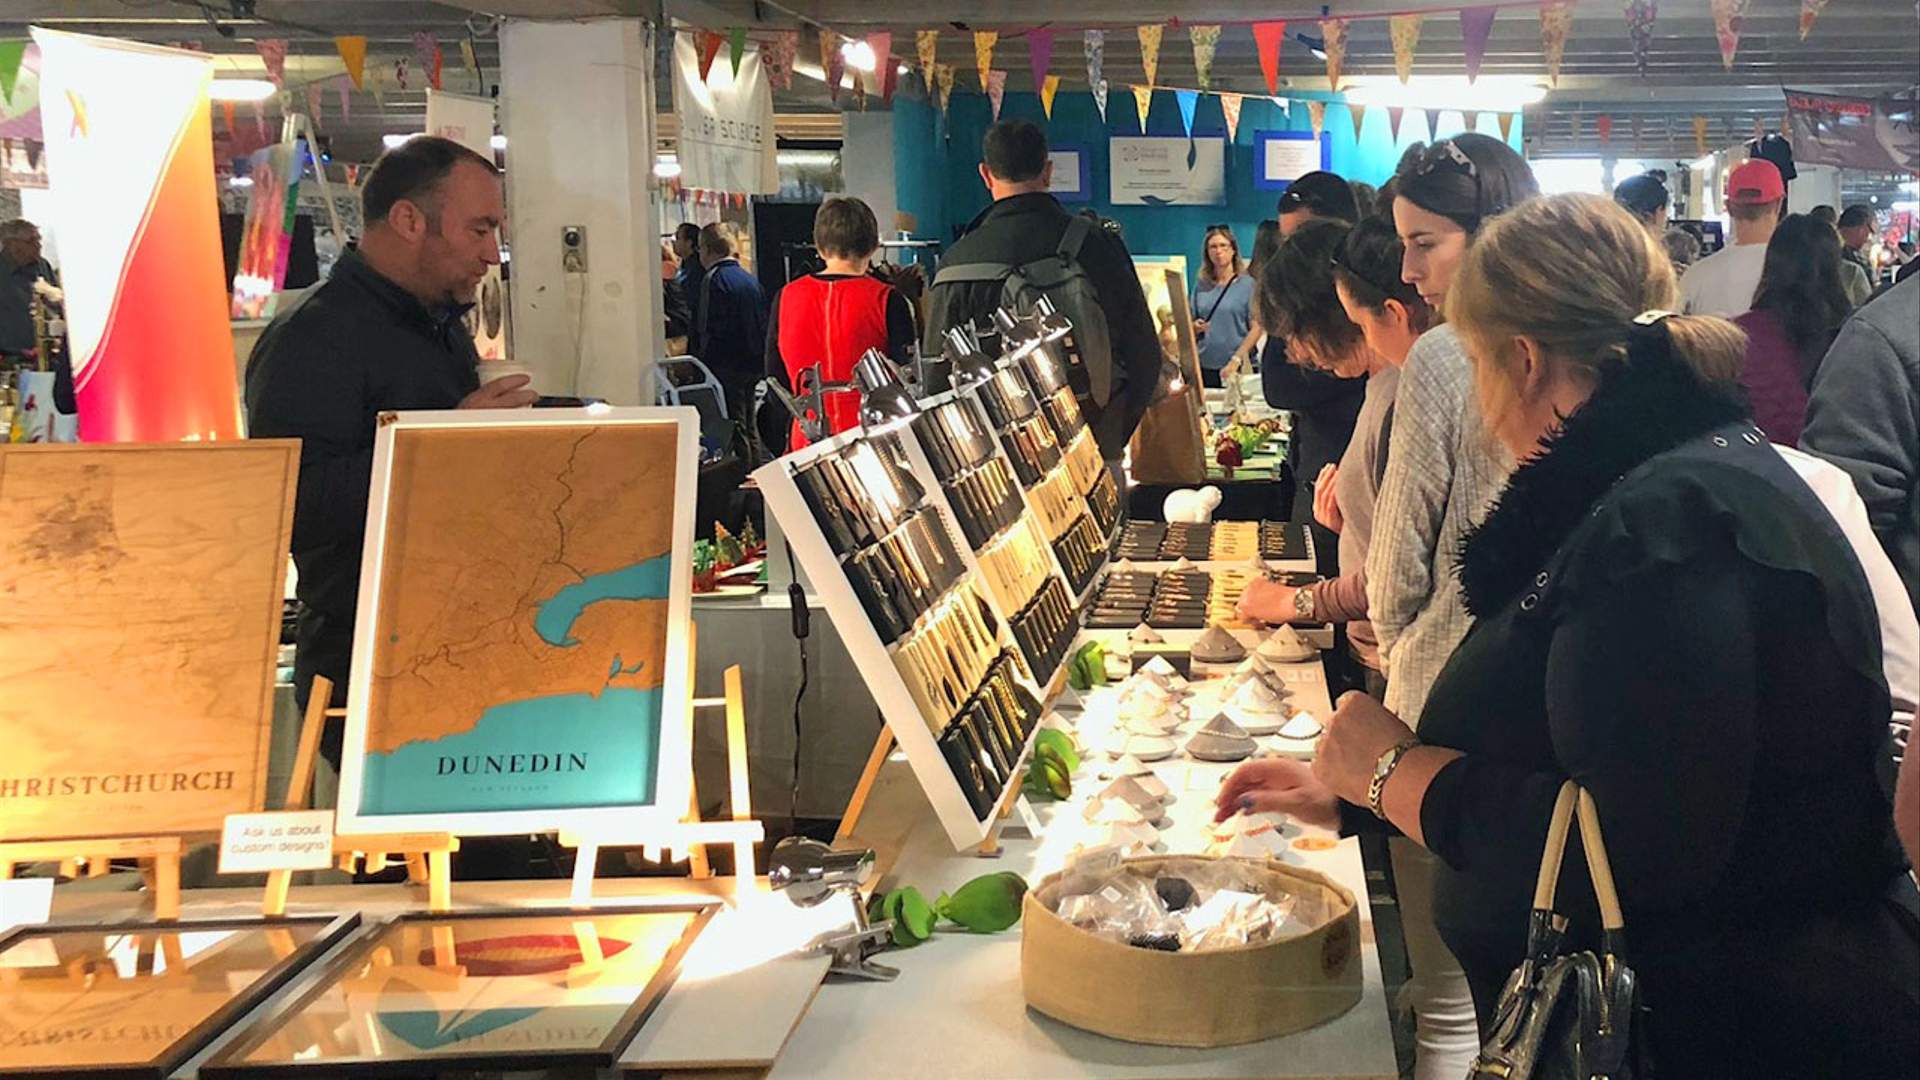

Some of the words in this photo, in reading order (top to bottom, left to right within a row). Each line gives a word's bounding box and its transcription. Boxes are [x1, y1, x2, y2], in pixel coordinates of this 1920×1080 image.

[720, 119, 762, 143] SCIENCE
[436, 752, 588, 776] DUNEDIN
[270, 826, 283, 836] us
[287, 824, 321, 836] about
[230, 842, 273, 854] custom
